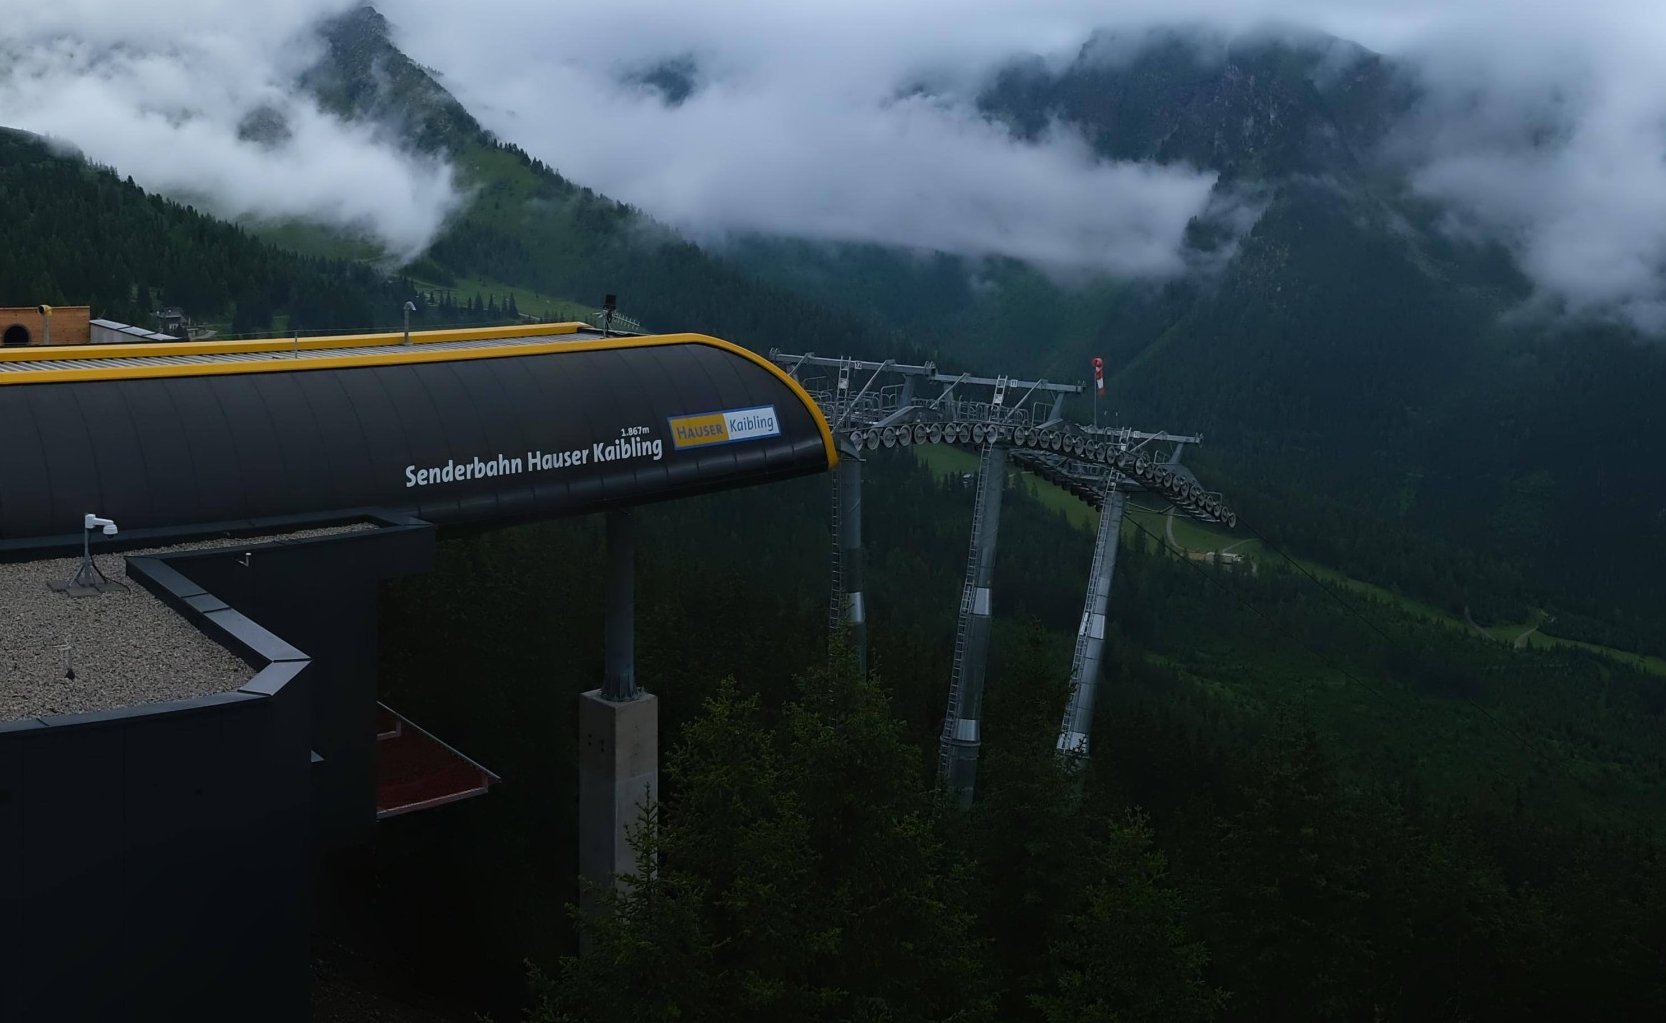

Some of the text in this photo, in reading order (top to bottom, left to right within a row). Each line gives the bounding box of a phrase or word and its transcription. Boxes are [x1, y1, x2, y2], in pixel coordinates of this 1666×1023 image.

[621, 426, 650, 437] 1.867m
[676, 415, 774, 440] HAUSER Kaibling
[405, 436, 663, 488] Senderbahn Hauser Kaibling
